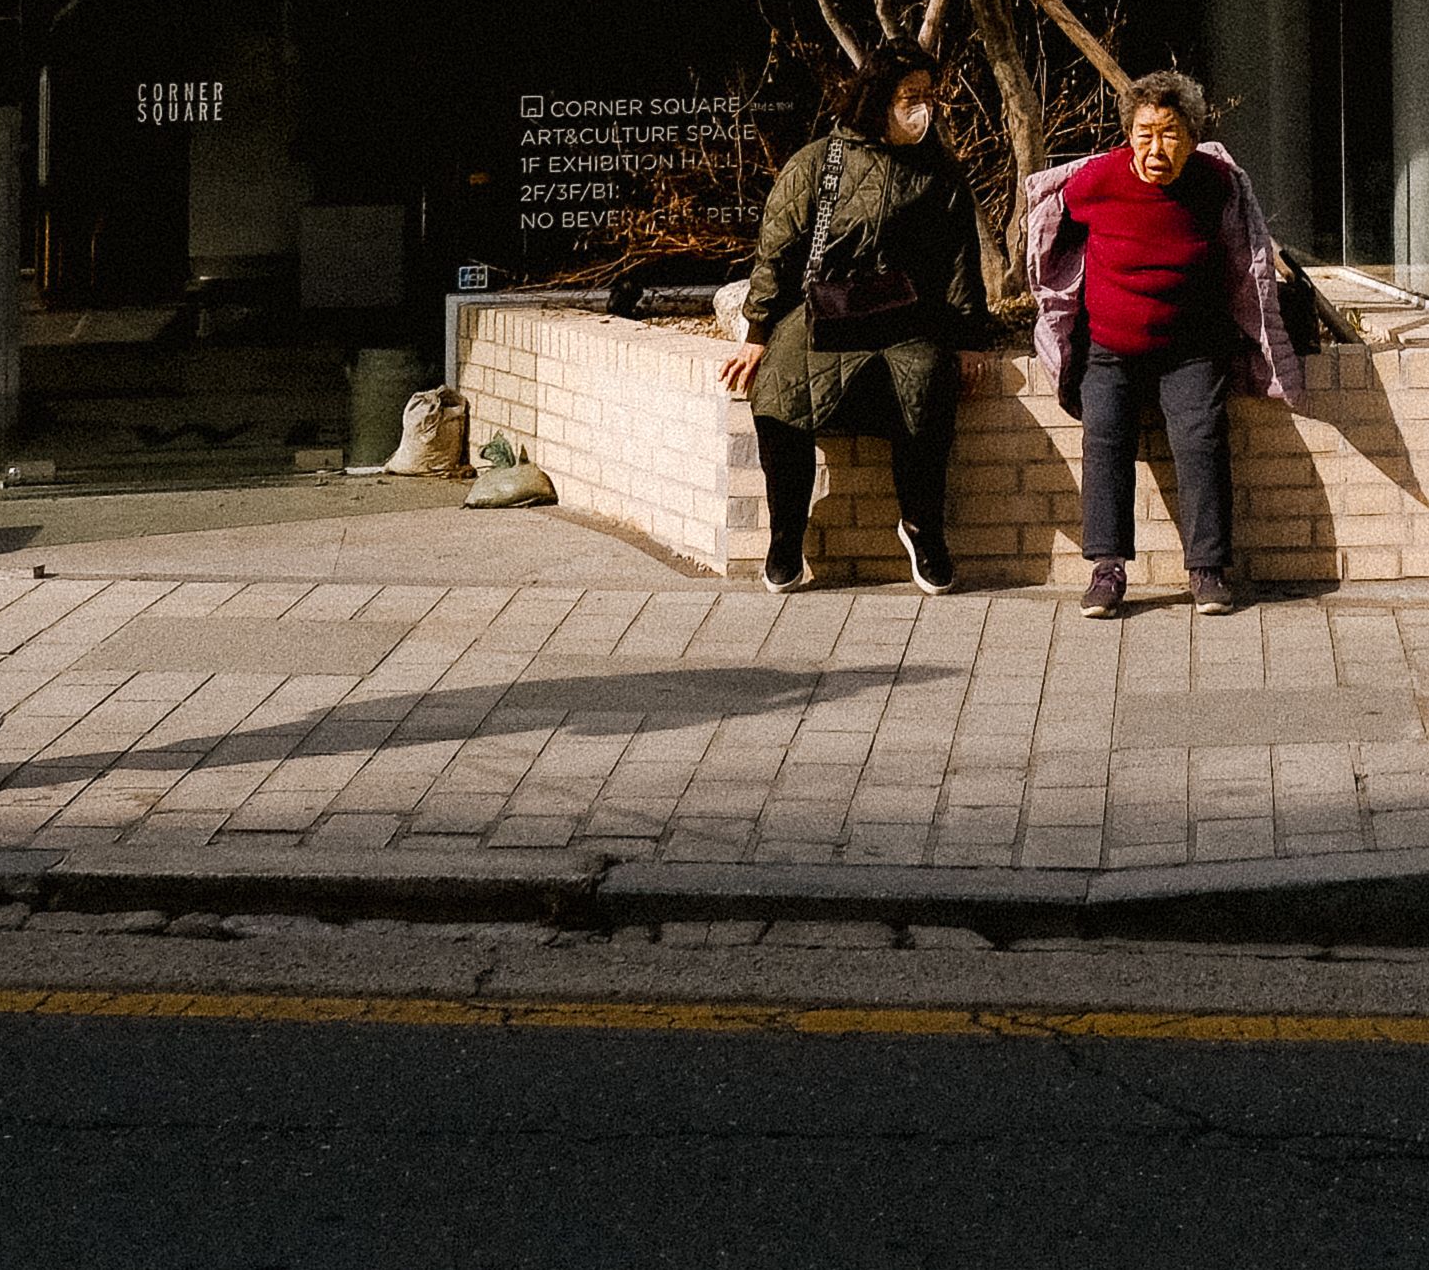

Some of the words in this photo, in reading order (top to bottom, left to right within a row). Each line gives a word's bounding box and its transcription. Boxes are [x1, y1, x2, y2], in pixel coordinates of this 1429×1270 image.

[137, 82, 223, 102] CORNER
[137, 101, 223, 126] SQUARE
[550, 99, 644, 118] CORNER
[650, 96, 740, 115] SQUARE
[521, 125, 679, 146] ART&CULTURE
[686, 124, 756, 142] SPACE
[521, 156, 540, 174] 1F
[549, 154, 674, 173] EXHIBITION
[681, 151, 738, 169] HALL
[521, 182, 620, 203] 2F/3F/B1:
[521, 211, 554, 229] NO
